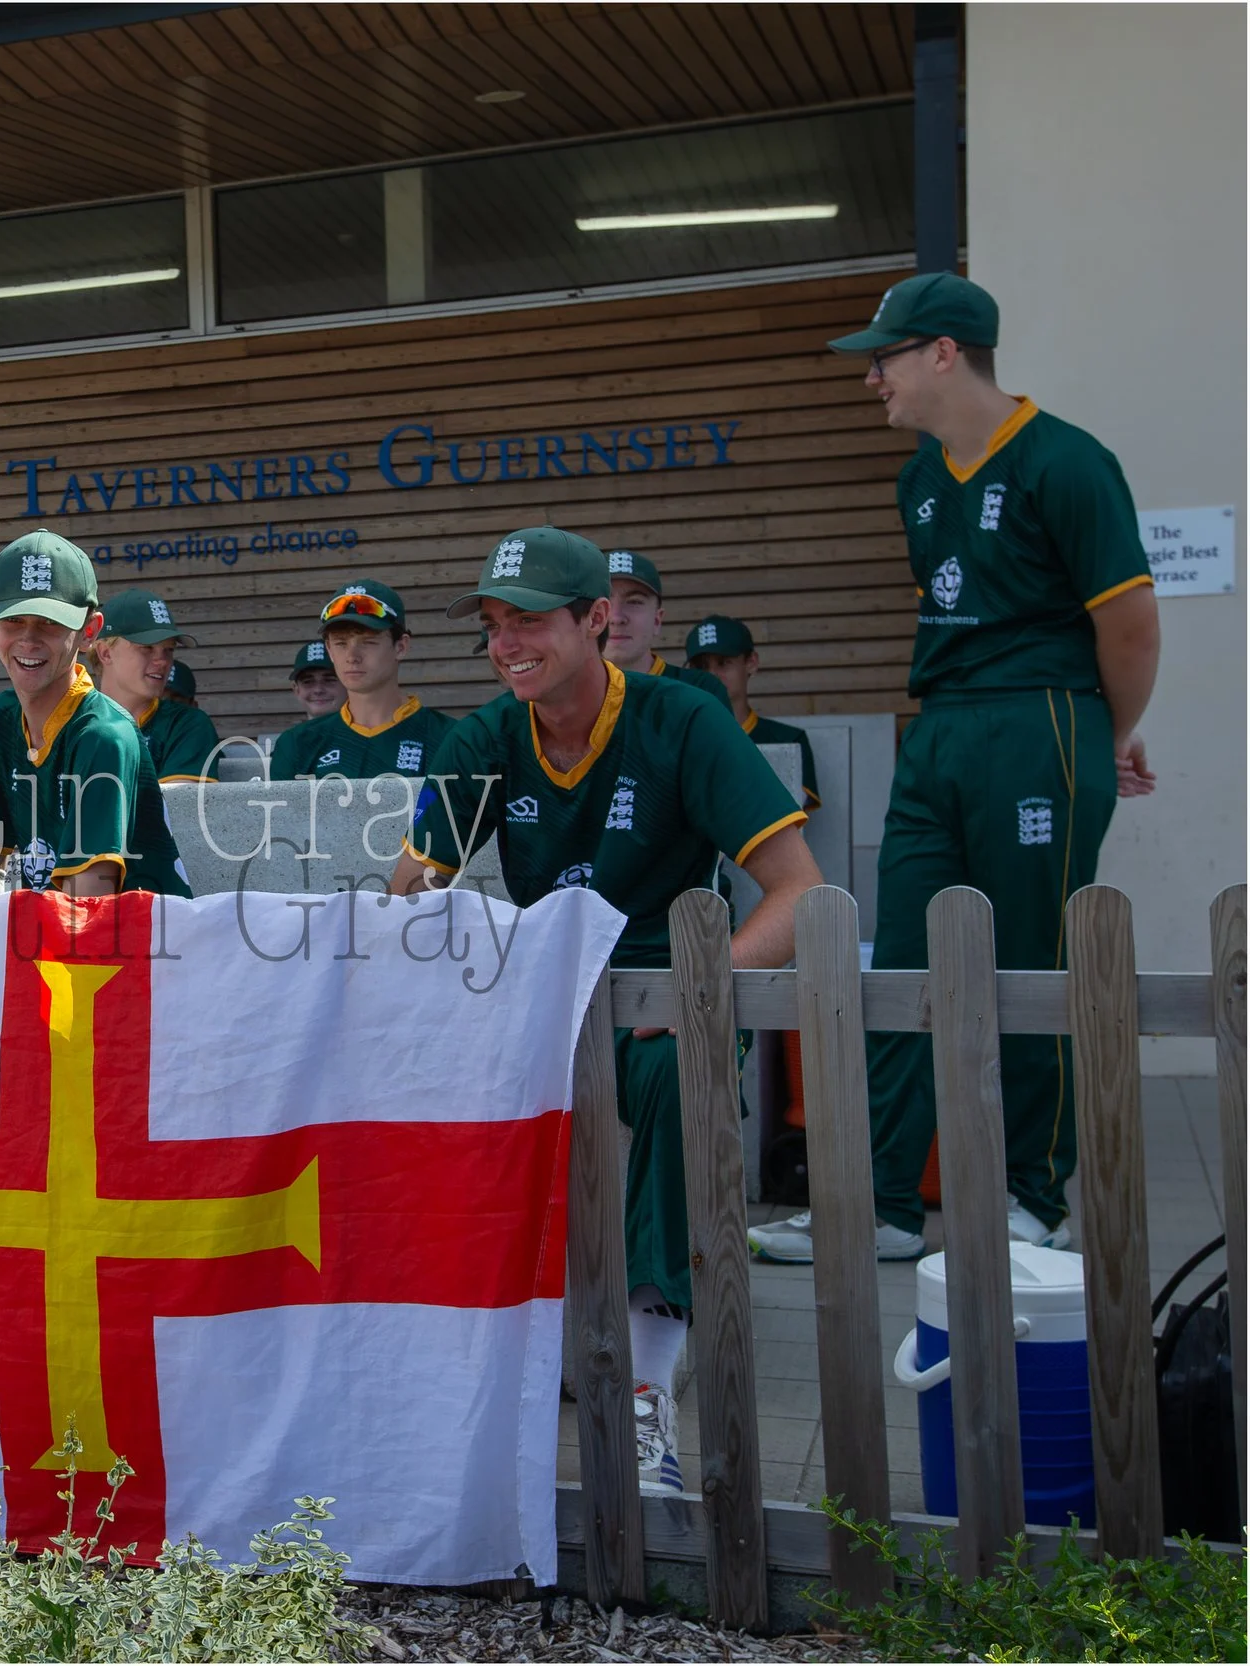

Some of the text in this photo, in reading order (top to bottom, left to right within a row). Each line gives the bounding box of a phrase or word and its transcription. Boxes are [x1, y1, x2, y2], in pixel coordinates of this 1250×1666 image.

[6, 456, 351, 517] TAVERNERS
[378, 421, 742, 489] GUERNSEY
[1149, 525, 1182, 540] The
[94, 543, 112, 565] a
[122, 532, 239, 571] sporting
[251, 522, 359, 555] chance
[1182, 545, 1219, 560] Best
[1154, 570, 1199, 582] rrace
